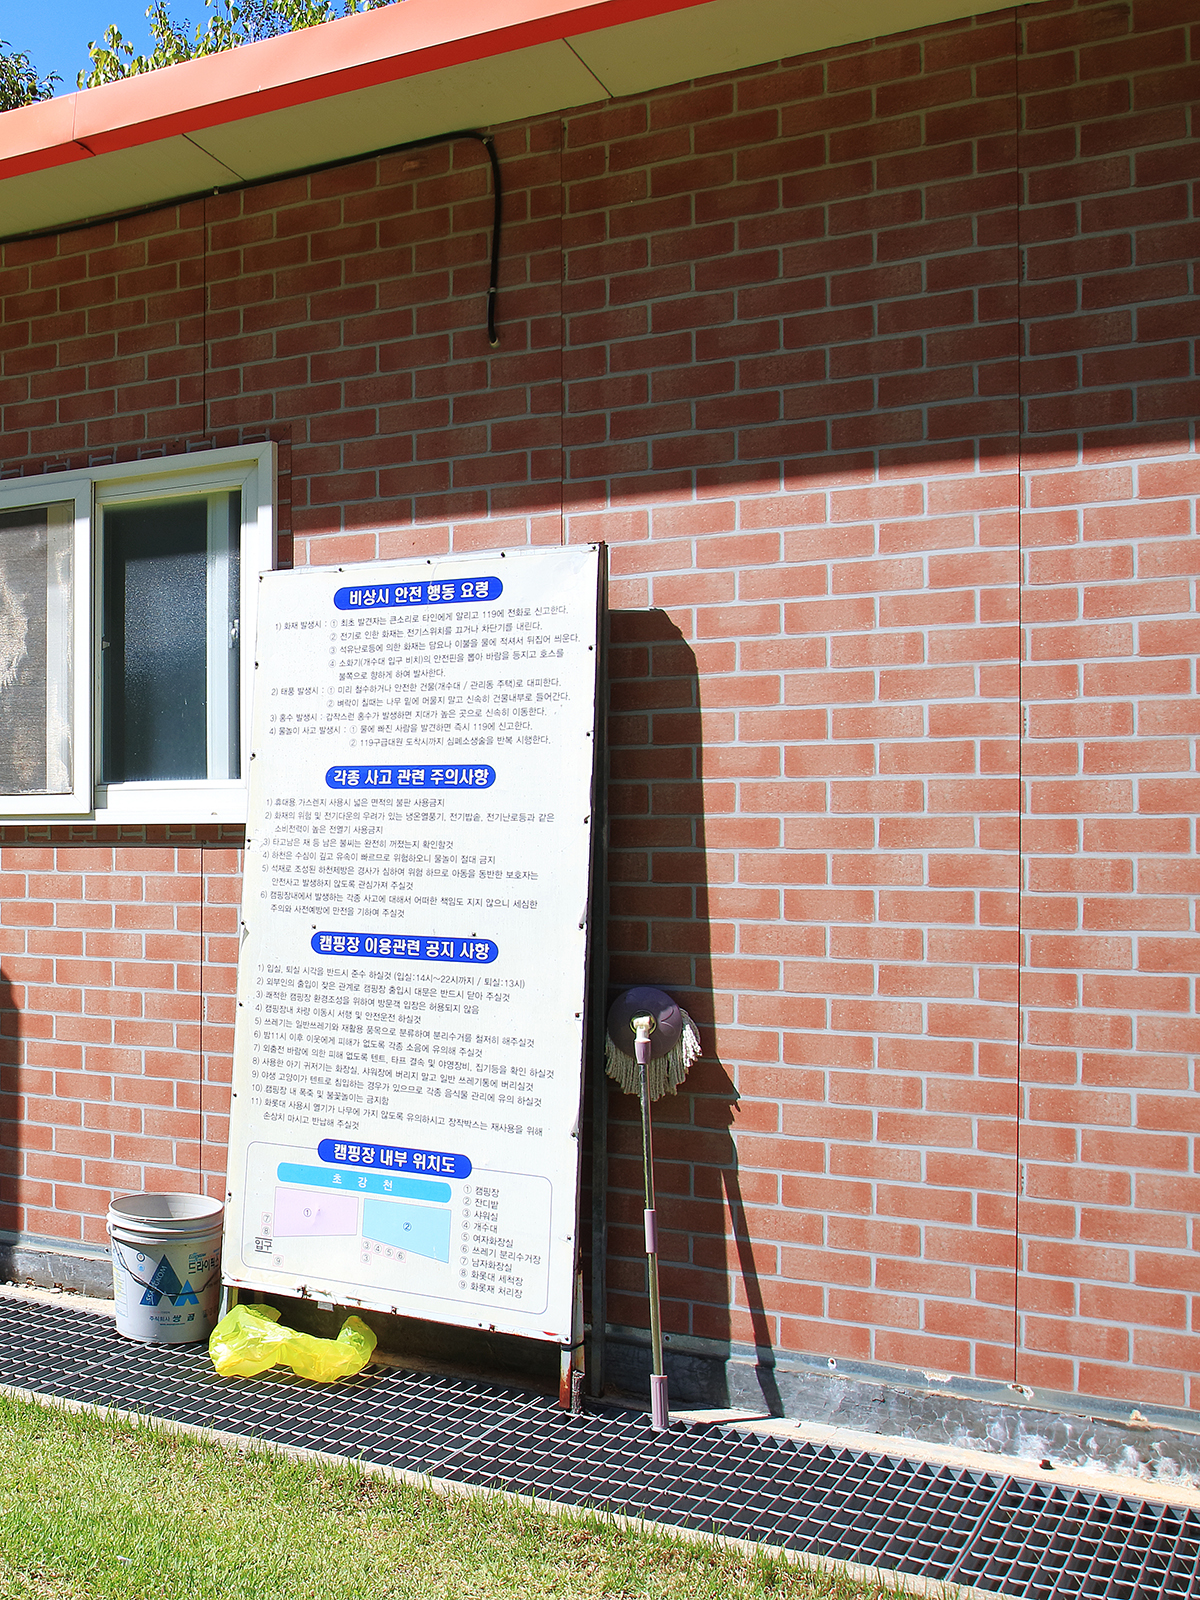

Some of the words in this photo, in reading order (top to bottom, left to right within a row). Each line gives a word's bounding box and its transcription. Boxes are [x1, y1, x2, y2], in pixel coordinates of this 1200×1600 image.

[349, 587, 389, 606] 비상시
[394, 585, 421, 603] 안전
[426, 583, 455, 601] 행동
[460, 580, 488, 598] 요령
[339, 631, 362, 641] 전기로
[363, 629, 379, 640] 인한
[381, 628, 404, 638] 화재는
[406, 625, 452, 638] 전기스위치를
[454, 624, 479, 634] 끄거나
[481, 622, 513, 633] 차단기를
[515, 620, 542, 631] 내린다.
[269, 713, 277, 722] 3)
[278, 712, 293, 723] 홍수
[295, 712, 318, 722] 발생시
[325, 711, 355, 722] 갑작스런
[357, 711, 380, 721] 홍수가
[381, 710, 412, 720] 발생하면
[414, 709, 438, 719] 지대가
[440, 708, 456, 719] 높은
[458, 708, 482, 718] 곳으로
[484, 707, 510, 717] 신속히
[511, 706, 547, 717] 이동한다.
[360, 737, 403, 747] 119구급대원
[405, 736, 444, 746] 도착시까지
[496, 735, 513, 745] 반복
[515, 734, 551, 745] 시행한다.
[333, 769, 360, 785] 각종
[364, 769, 392, 785] 사고
[396, 768, 425, 785] 관련
[429, 768, 489, 785] 주의사항
[266, 797, 273, 807] 1)
[274, 797, 296, 807] 휴대용
[298, 797, 327, 807] 가스렌지
[328, 797, 351, 807] 사용시
[370, 798, 394, 807] 면적의
[413, 797, 445, 808] 사용금지
[262, 850, 270, 859] 4)
[271, 850, 292, 860] 하천은
[319, 851, 333, 861] 깊고
[335, 851, 358, 861] 유속이
[360, 852, 390, 862] 빠르므로
[392, 852, 431, 863] 위험하오니
[433, 853, 458, 864] 물놀이
[460, 854, 476, 864] 절대
[478, 854, 496, 865] 금지
[271, 877, 299, 886] 안전사고
[301, 878, 331, 888] 발생하지
[333, 878, 356, 888] 않도록
[357, 879, 388, 890] 관심가져
[390, 880, 413, 891] 주실것
[270, 903, 292, 913] 주의와
[293, 904, 330, 915] 사전예방에
[332, 906, 354, 916] 만전을
[356, 907, 380, 917] 기하여
[381, 908, 405, 918] 주실것
[319, 934, 360, 953] 캠핑장
[364, 937, 420, 956] 이용관련
[425, 940, 454, 958] 공지
[459, 942, 490, 960] 사항
[255, 989, 263, 999] 3)
[289, 992, 312, 1003] 캠핑장
[313, 993, 350, 1005] 환경조성을
[352, 996, 375, 1007] 위하여
[377, 998, 400, 1009] 방문객
[402, 1000, 426, 1011] 입장은
[428, 1001, 461, 1013] 허용되지
[462, 1004, 479, 1015] 않음
[254, 1002, 262, 1012] 4)
[264, 1003, 293, 1014] 캠핑장내
[295, 1006, 311, 1016] 차량
[312, 1007, 335, 1018] 이동시
[336, 1009, 352, 1020] 서행
[354, 1010, 362, 1020] 및
[364, 1011, 396, 1022] 안전운전
[397, 1013, 421, 1025] 하실것
[254, 1016, 262, 1026] 5)
[263, 1017, 293, 1028] 쓰레기는
[294, 1019, 339, 1032] 일반쓰레기와
[340, 1023, 363, 1034] 재활용
[398, 1028, 430, 1039] 분류하여
[432, 1030, 472, 1043] 분리수거를
[474, 1033, 499, 1045] 철저히
[501, 1036, 534, 1048] 해주실것
[253, 1029, 261, 1039] 6)
[262, 1030, 286, 1041] 밤11시
[288, 1032, 304, 1042] 이후
[305, 1034, 336, 1045] 이웃에게
[337, 1036, 360, 1047] 피해가
[362, 1038, 385, 1049] 없도록
[388, 1040, 403, 1052] 각종
[405, 1042, 429, 1053] 소음에
[431, 1044, 456, 1056] 유의해
[458, 1046, 482, 1058] 주실것
[333, 1143, 375, 1164] 캠핑장
[379, 1148, 407, 1167] 내부
[412, 1152, 455, 1173] 위치도
[331, 1172, 342, 1184] 초
[357, 1176, 368, 1188] 강
[382, 1178, 393, 1192] 천
[474, 1185, 500, 1198] 캠핑장
[474, 1197, 499, 1210] 잔디밭
[473, 1210, 498, 1222] 샤워실
[473, 1221, 498, 1234] 개수대
[255, 1240, 273, 1250] 입구
[472, 1233, 513, 1248] 여자화장실
[471, 1246, 496, 1258] 쓰레기
[499, 1249, 541, 1265] 분리수거장
[471, 1257, 512, 1273] 남자화장실
[470, 1269, 495, 1282] 화롯대
[497, 1274, 523, 1287] 세척장
[469, 1281, 495, 1294] 화롯재
[497, 1285, 523, 1299] 처리장
